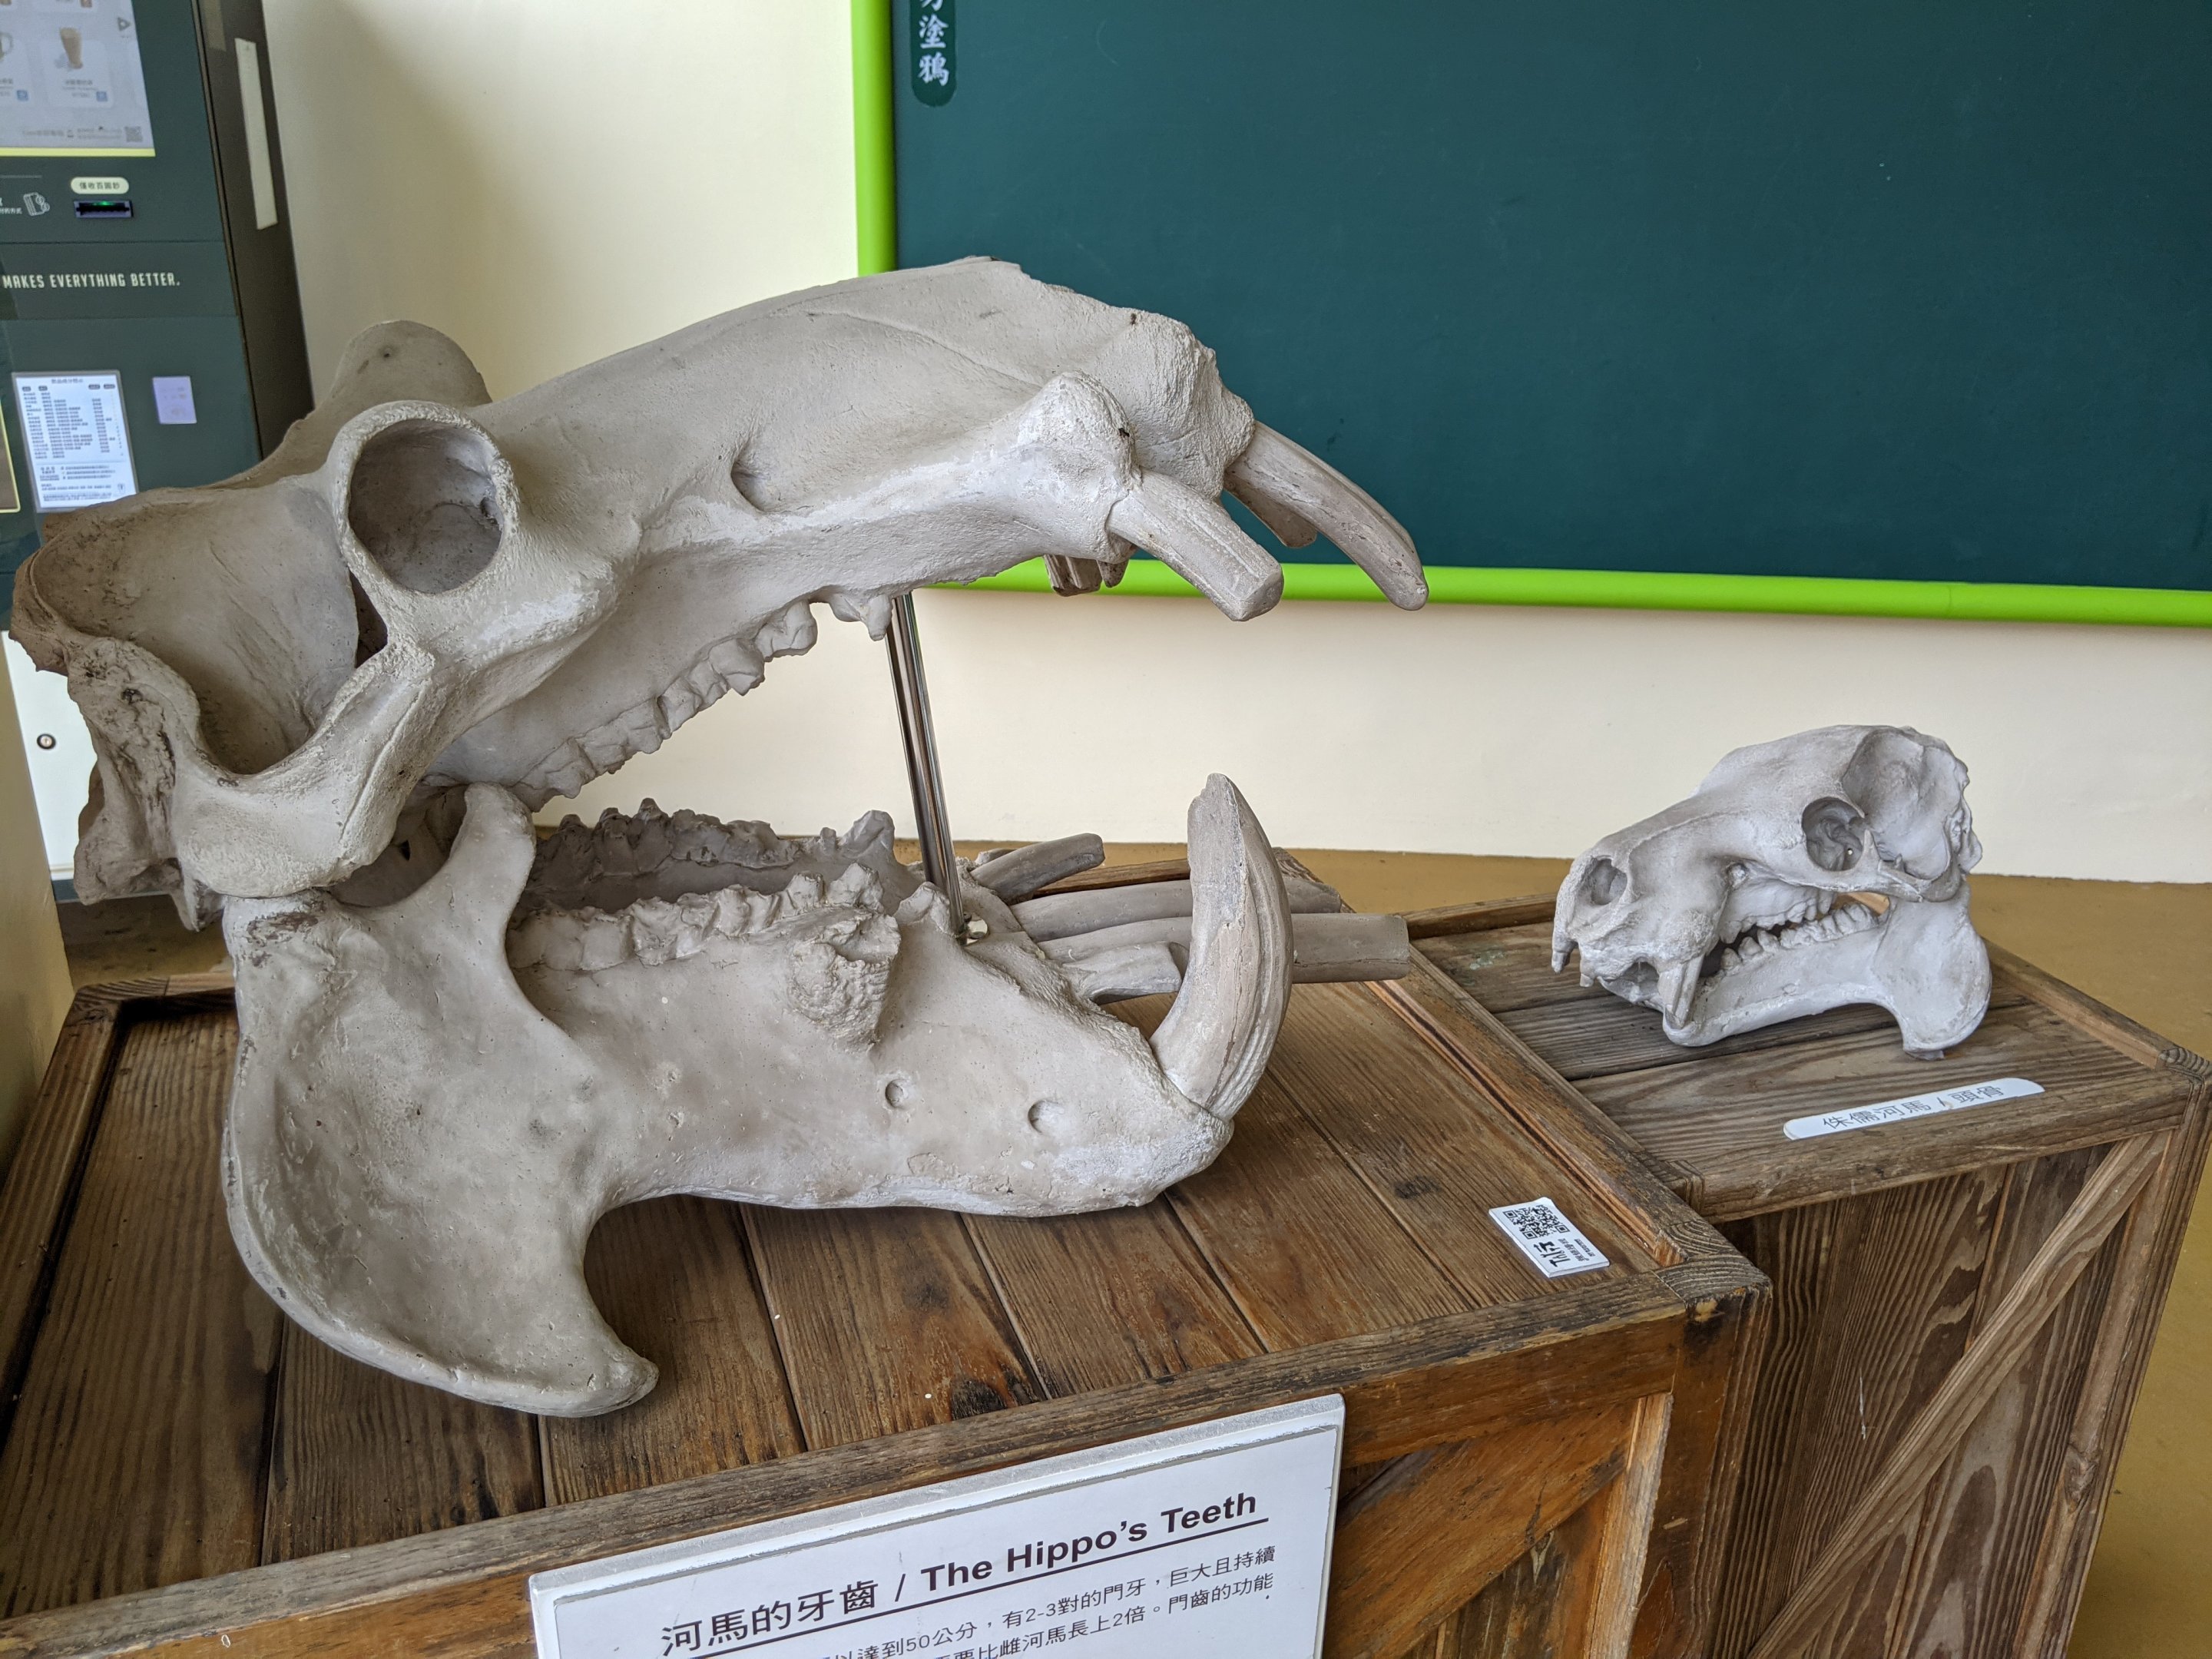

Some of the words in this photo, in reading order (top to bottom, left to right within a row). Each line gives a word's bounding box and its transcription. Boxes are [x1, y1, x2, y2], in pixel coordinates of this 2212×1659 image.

[2, 274, 45, 289] MAKES
[49, 273, 126, 288] EVERYTHING
[130, 272, 180, 286] BETTER.
[1823, 1099, 1932, 1131] 侏儒河馬
[1948, 1084, 2005, 1104] 頭骨
[661, 1580, 879, 1657] 河馬的牙齒
[895, 1573, 906, 1602] /
[921, 1559, 992, 1592] The
[1007, 1521, 1147, 1572] Hippo’s
[1161, 1492, 1256, 1534] Teeth
